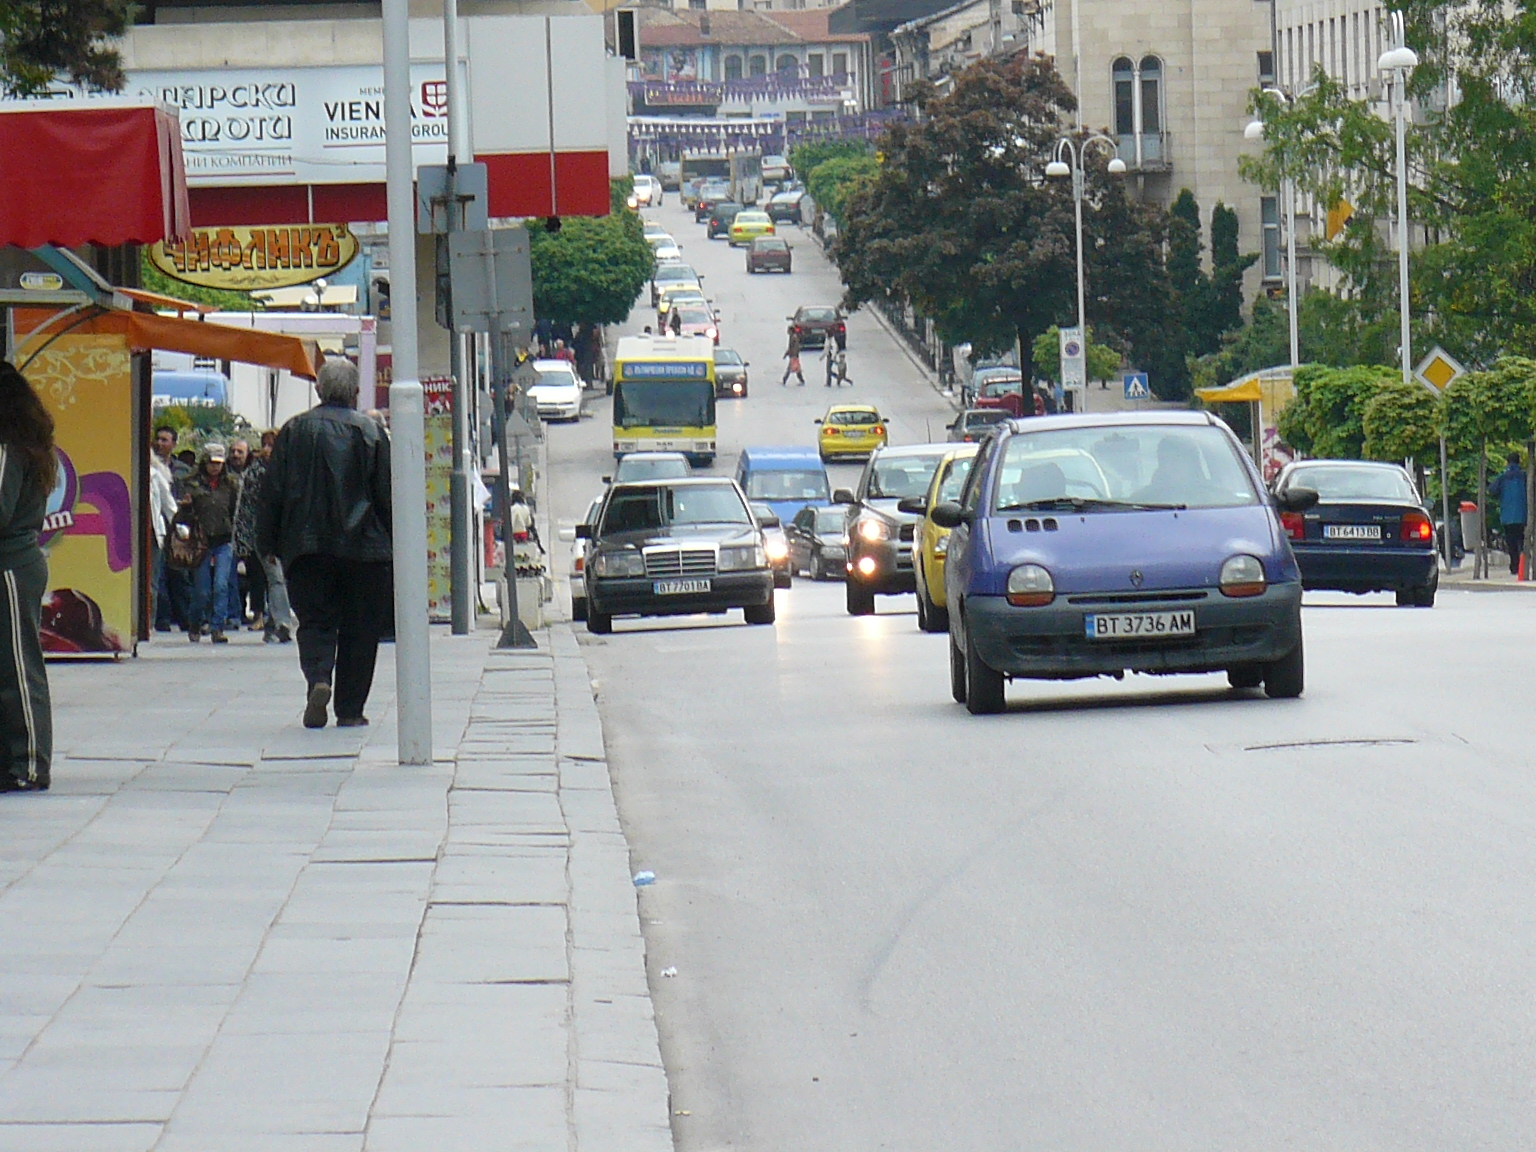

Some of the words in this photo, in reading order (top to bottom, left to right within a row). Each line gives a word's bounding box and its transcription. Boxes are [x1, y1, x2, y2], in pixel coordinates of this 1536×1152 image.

[180, 115, 293, 142] МОТИ
[1097, 616, 1119, 634] BT
[1123, 615, 1165, 633] 3736
[1169, 613, 1191, 631] AM
